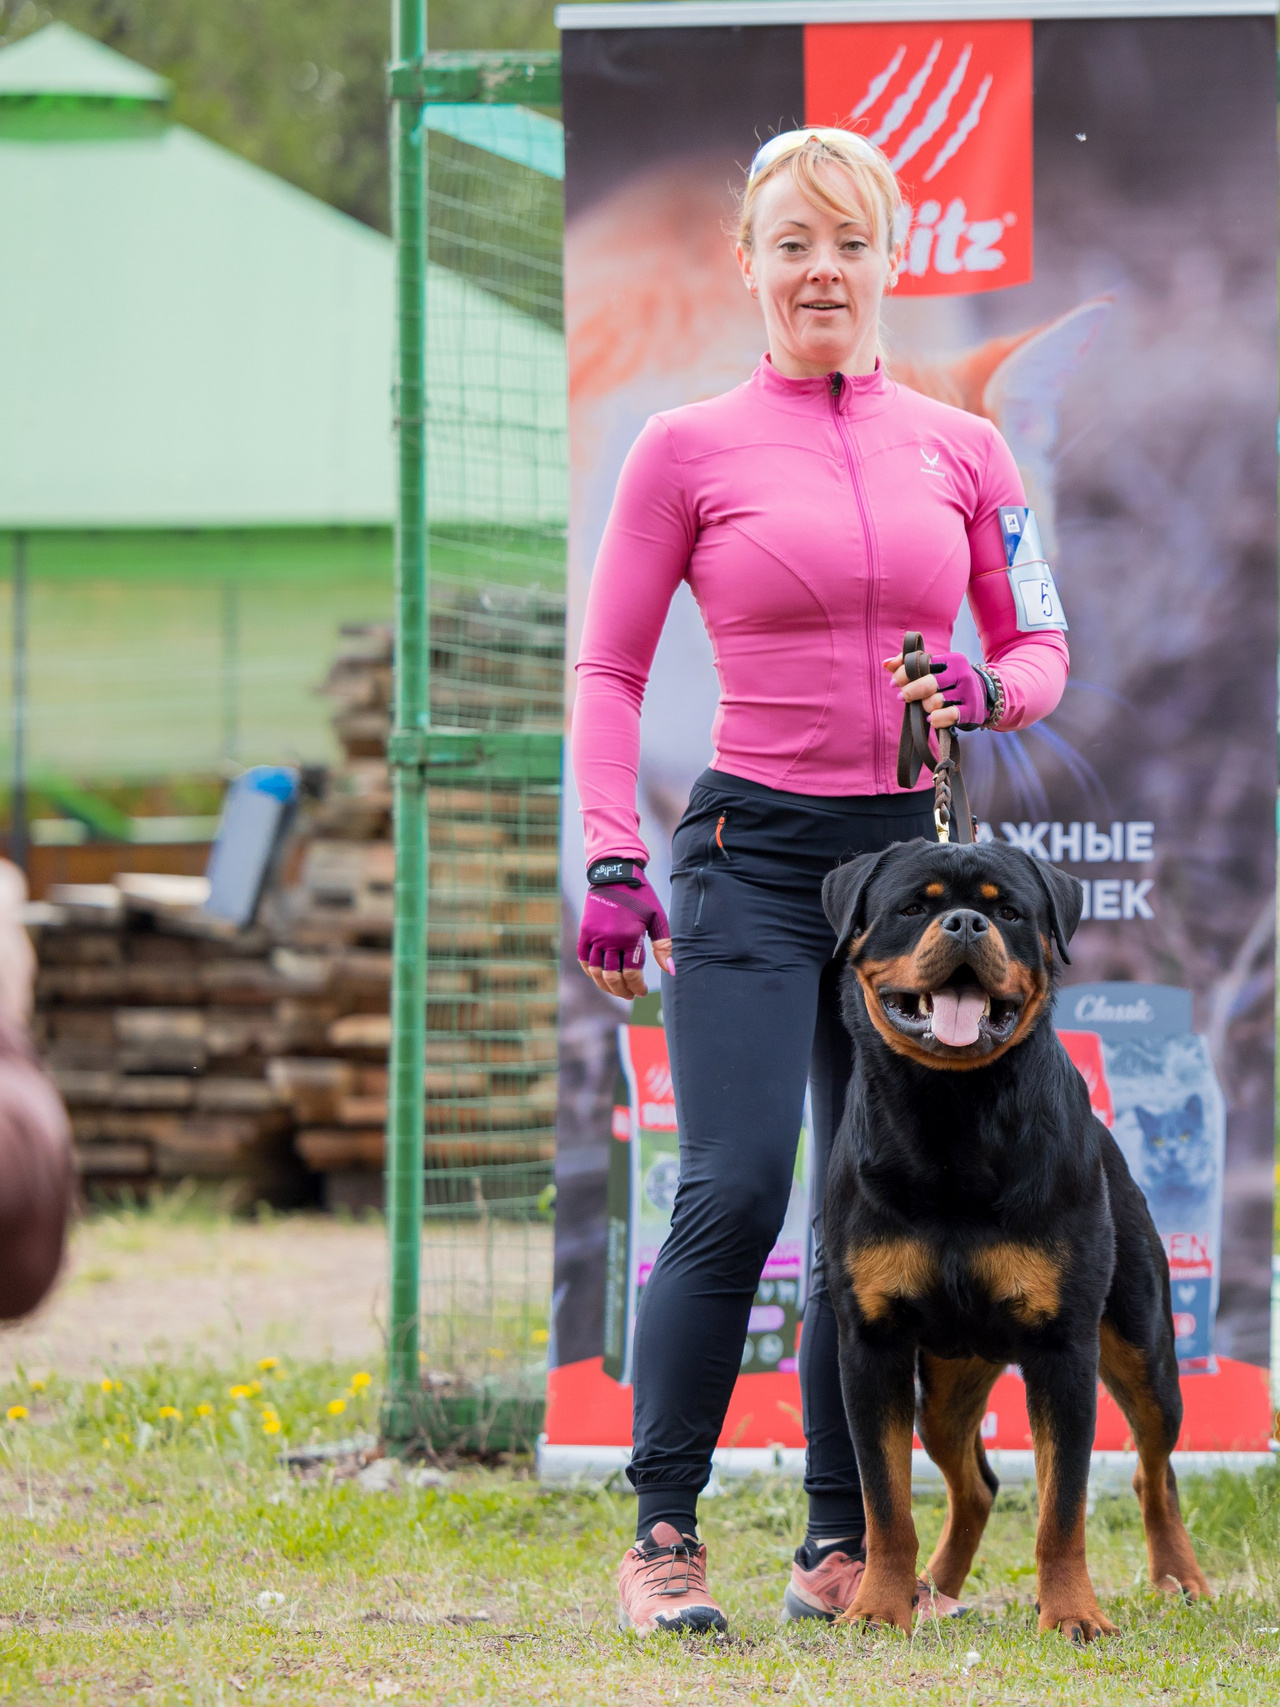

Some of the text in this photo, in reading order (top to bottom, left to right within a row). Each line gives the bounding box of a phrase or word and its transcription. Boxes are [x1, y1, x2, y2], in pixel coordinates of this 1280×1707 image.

[893, 197, 1006, 277] litz
[1041, 582, 1053, 617] 5
[1082, 879, 1155, 920] ЕК
[1170, 1232, 1210, 1259] EN
